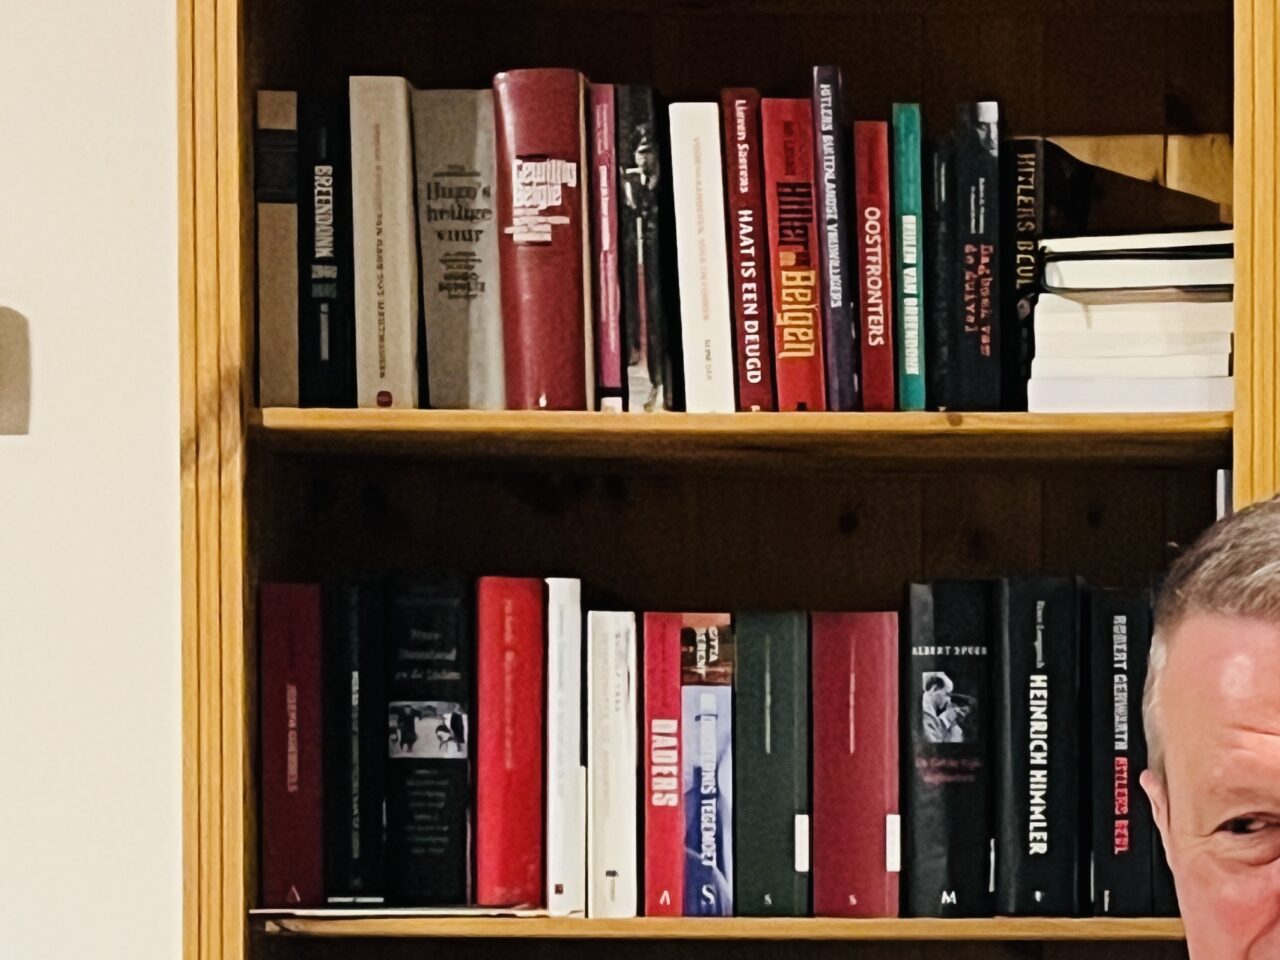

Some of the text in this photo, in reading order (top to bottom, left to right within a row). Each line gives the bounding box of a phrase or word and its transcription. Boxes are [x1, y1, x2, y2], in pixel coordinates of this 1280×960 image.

[314, 165, 335, 258] BREENDONK
[1015, 153, 1037, 231] HITLERS
[738, 210, 763, 384] HAAT IS EEN DEUGD
[775, 269, 818, 360] Belgen
[864, 207, 885, 346] OOSTFRONTERS
[911, 646, 951, 656] ALBERT
[652, 718, 680, 807] DADERS
[1029, 674, 1048, 765] HEINRICH
[1029, 769, 1049, 855] HIMMLER
